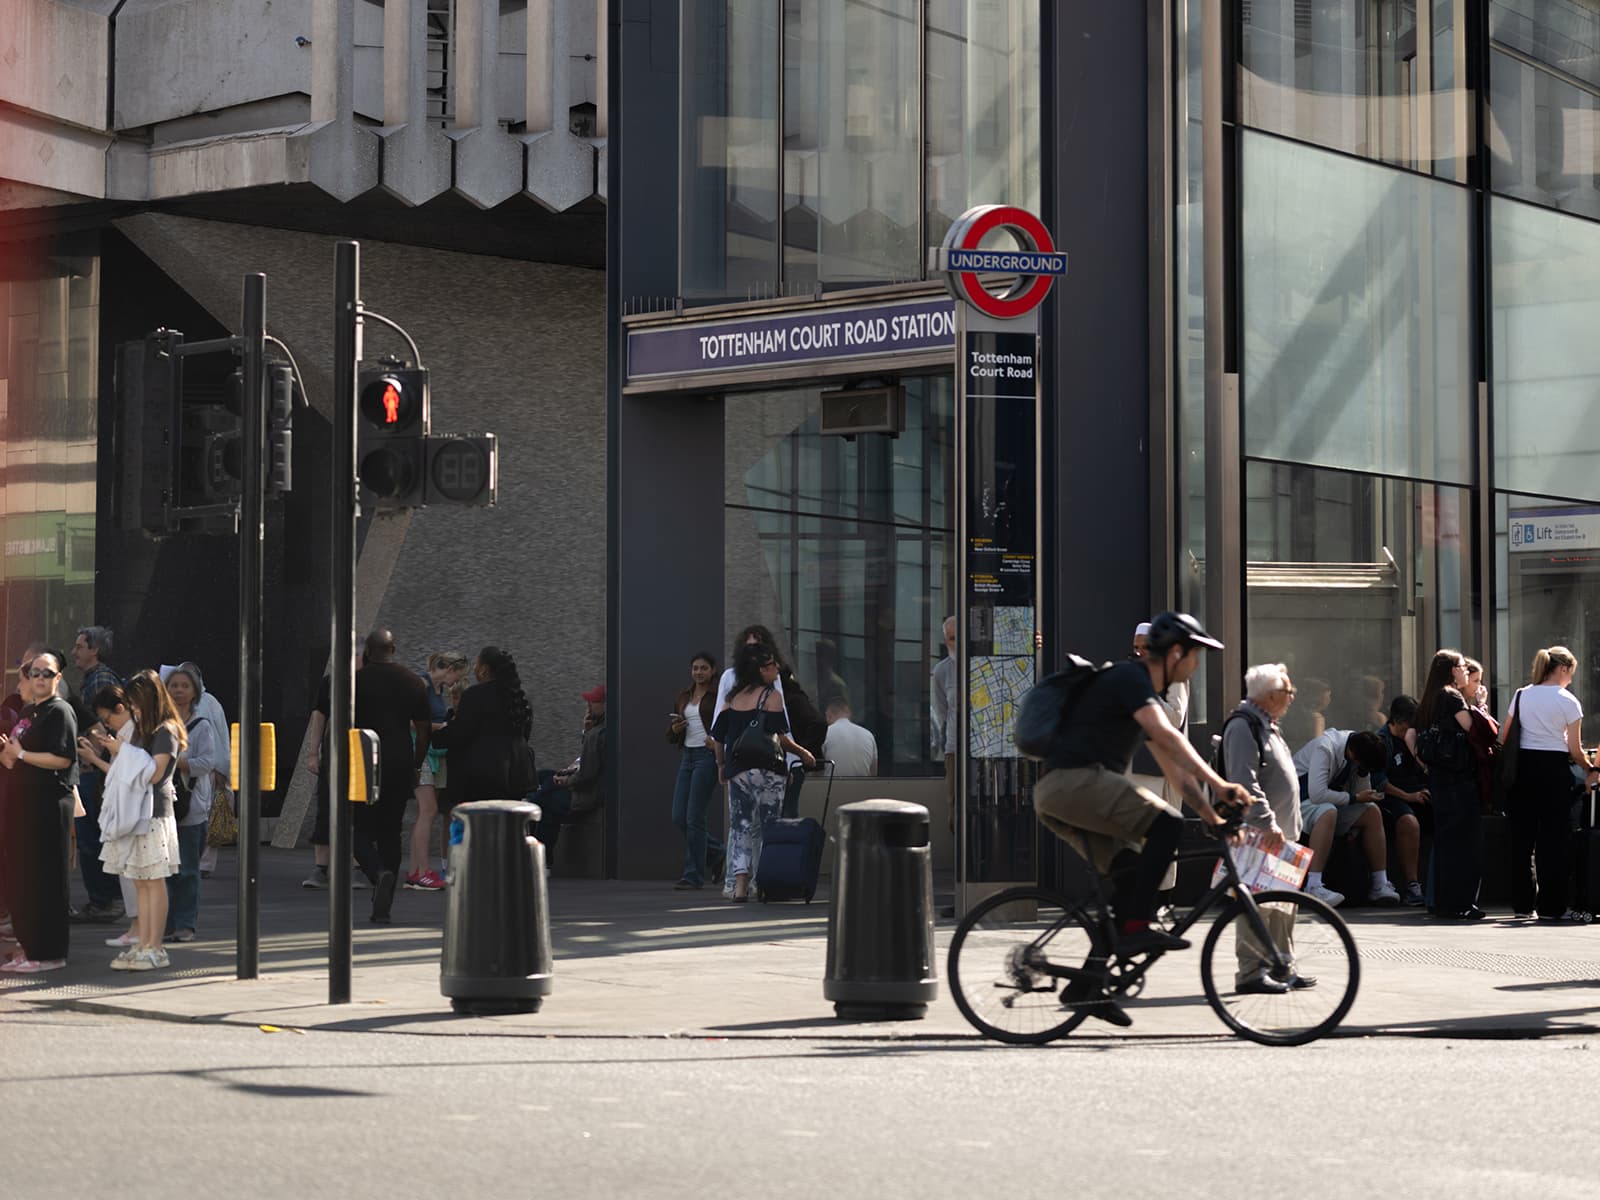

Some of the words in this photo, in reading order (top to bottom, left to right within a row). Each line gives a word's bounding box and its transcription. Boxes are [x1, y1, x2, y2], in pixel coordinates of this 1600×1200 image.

[951, 253, 1063, 271] UNDERGROUND
[699, 328, 787, 360] TOTTENHAM
[789, 322, 841, 351] COURT
[844, 317, 888, 345] ROAD
[890, 309, 956, 342] STATION
[971, 351, 1033, 365] Tottenham
[970, 365, 1005, 378] Court
[1006, 366, 1034, 379] Road
[1536, 526, 1552, 540] Lift
